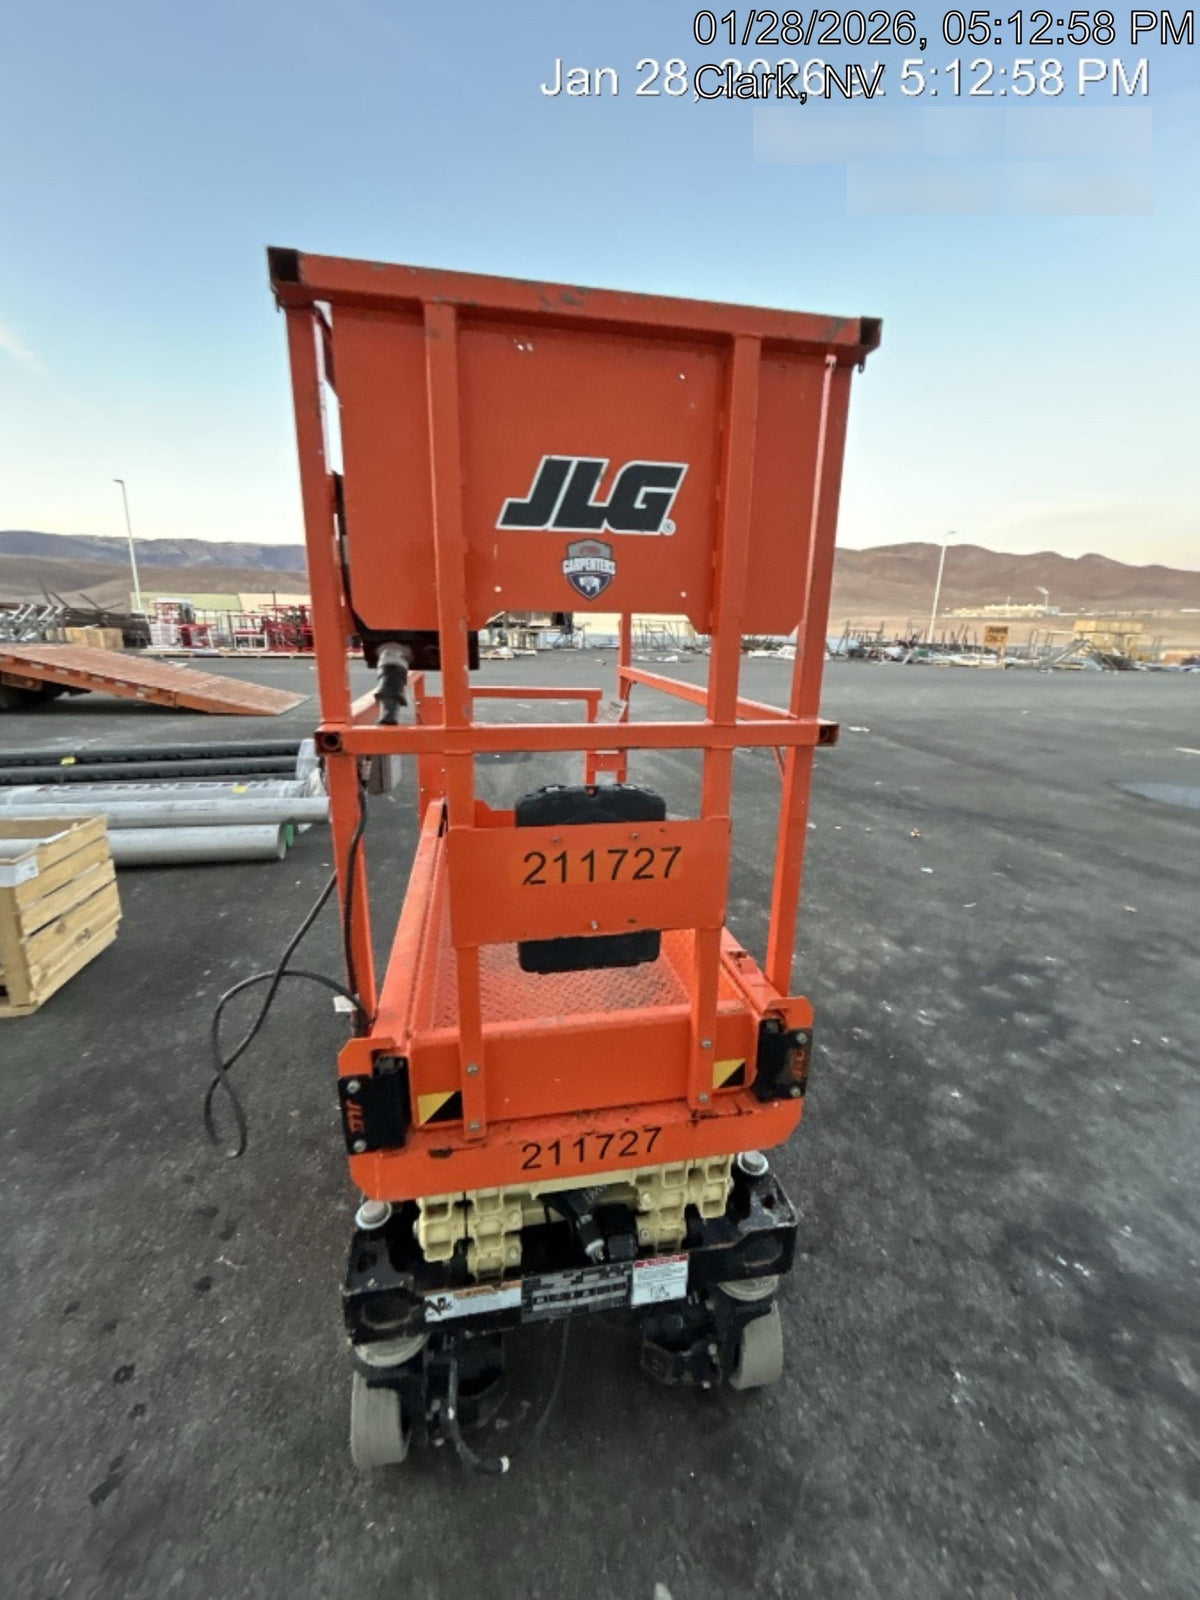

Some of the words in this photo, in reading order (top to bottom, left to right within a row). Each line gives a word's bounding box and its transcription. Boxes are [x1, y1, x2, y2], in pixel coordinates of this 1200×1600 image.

[496, 455, 689, 535] JLG
[523, 846, 682, 886] 211727
[521, 1127, 662, 1170] 211727
